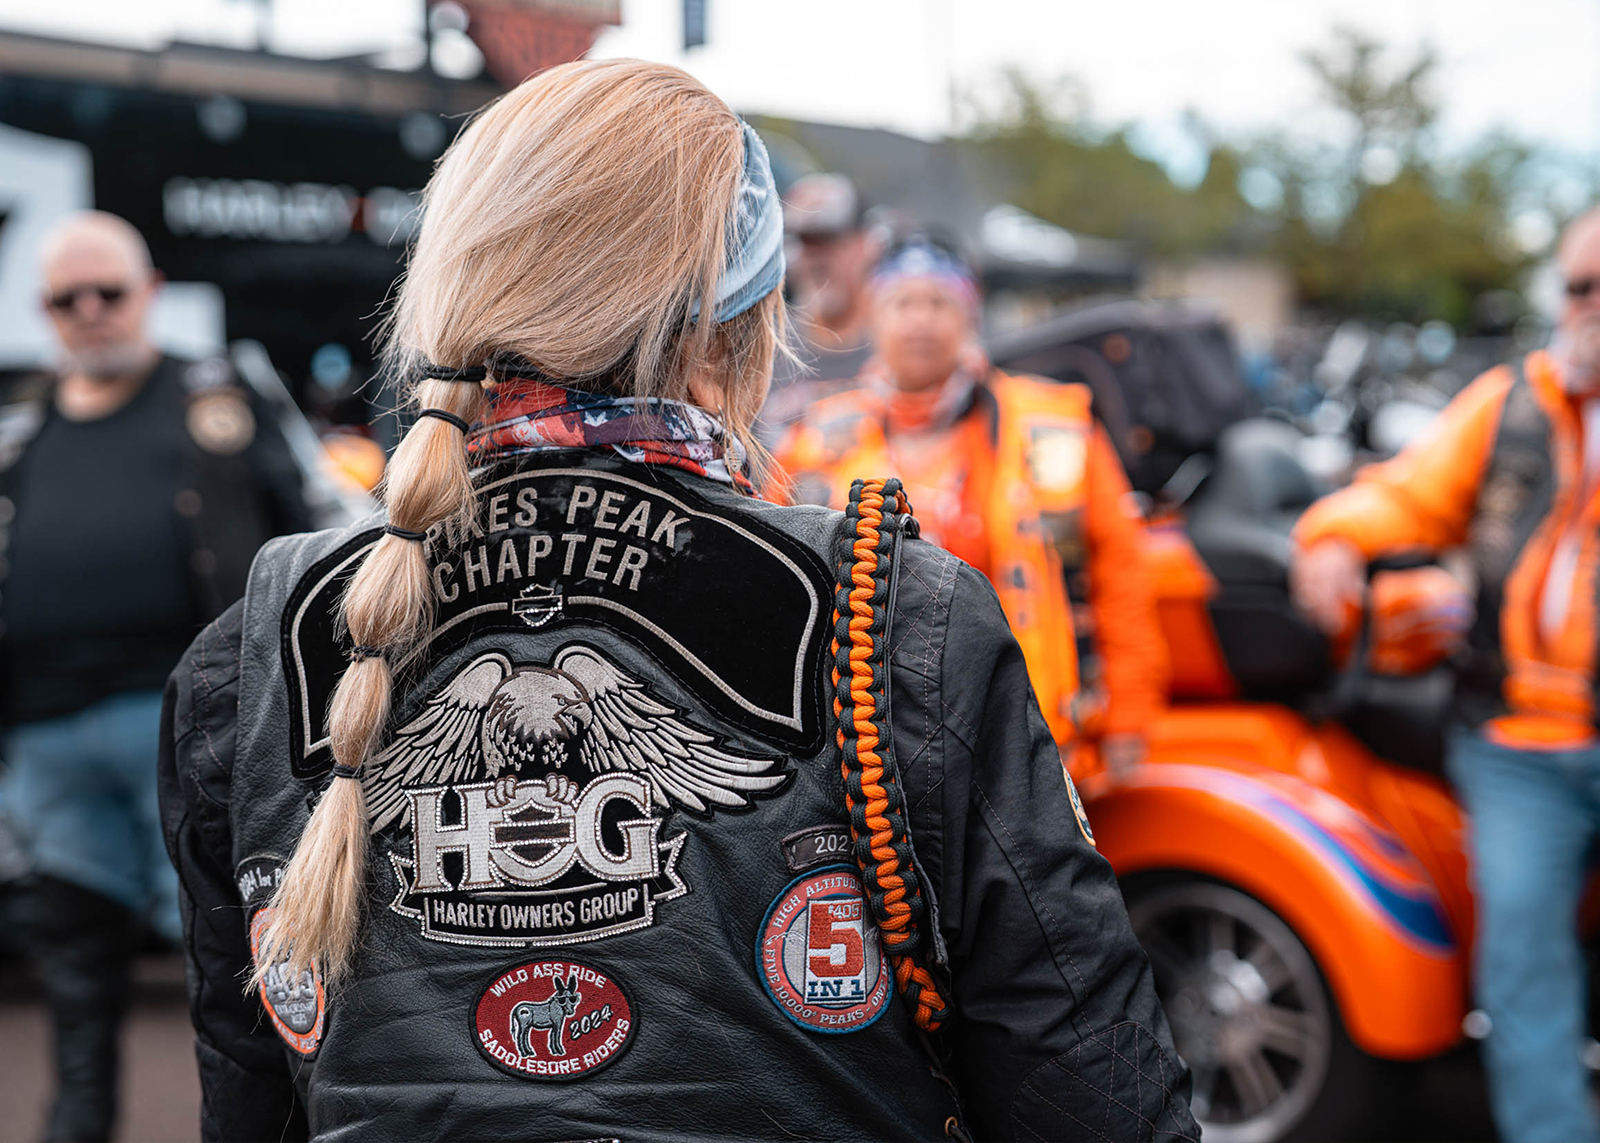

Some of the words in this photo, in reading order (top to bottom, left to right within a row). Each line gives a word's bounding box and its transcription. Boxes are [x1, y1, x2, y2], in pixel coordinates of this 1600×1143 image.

[566, 485, 690, 549] PEAK
[433, 533, 649, 603] CHAPTER
[401, 771, 662, 894] HOG
[433, 898, 496, 929] HARLEY
[500, 896, 575, 930] OWNERS
[579, 888, 639, 926] GROUP
[772, 894, 802, 928] HIGH
[809, 901, 864, 978] 5
[489, 969, 529, 998] WILD
[533, 963, 564, 979] ASS
[568, 965, 607, 989] RIDE
[764, 949, 781, 984] FIVE
[819, 1007, 865, 1025] PEAKS
[871, 979, 887, 1007] ONE
[807, 979, 842, 997] IN
[850, 979, 864, 996] 1
[479, 1028, 582, 1074] SADDLESORE
[583, 1018, 630, 1068] RIDERS
[569, 1003, 614, 1040] 2024
